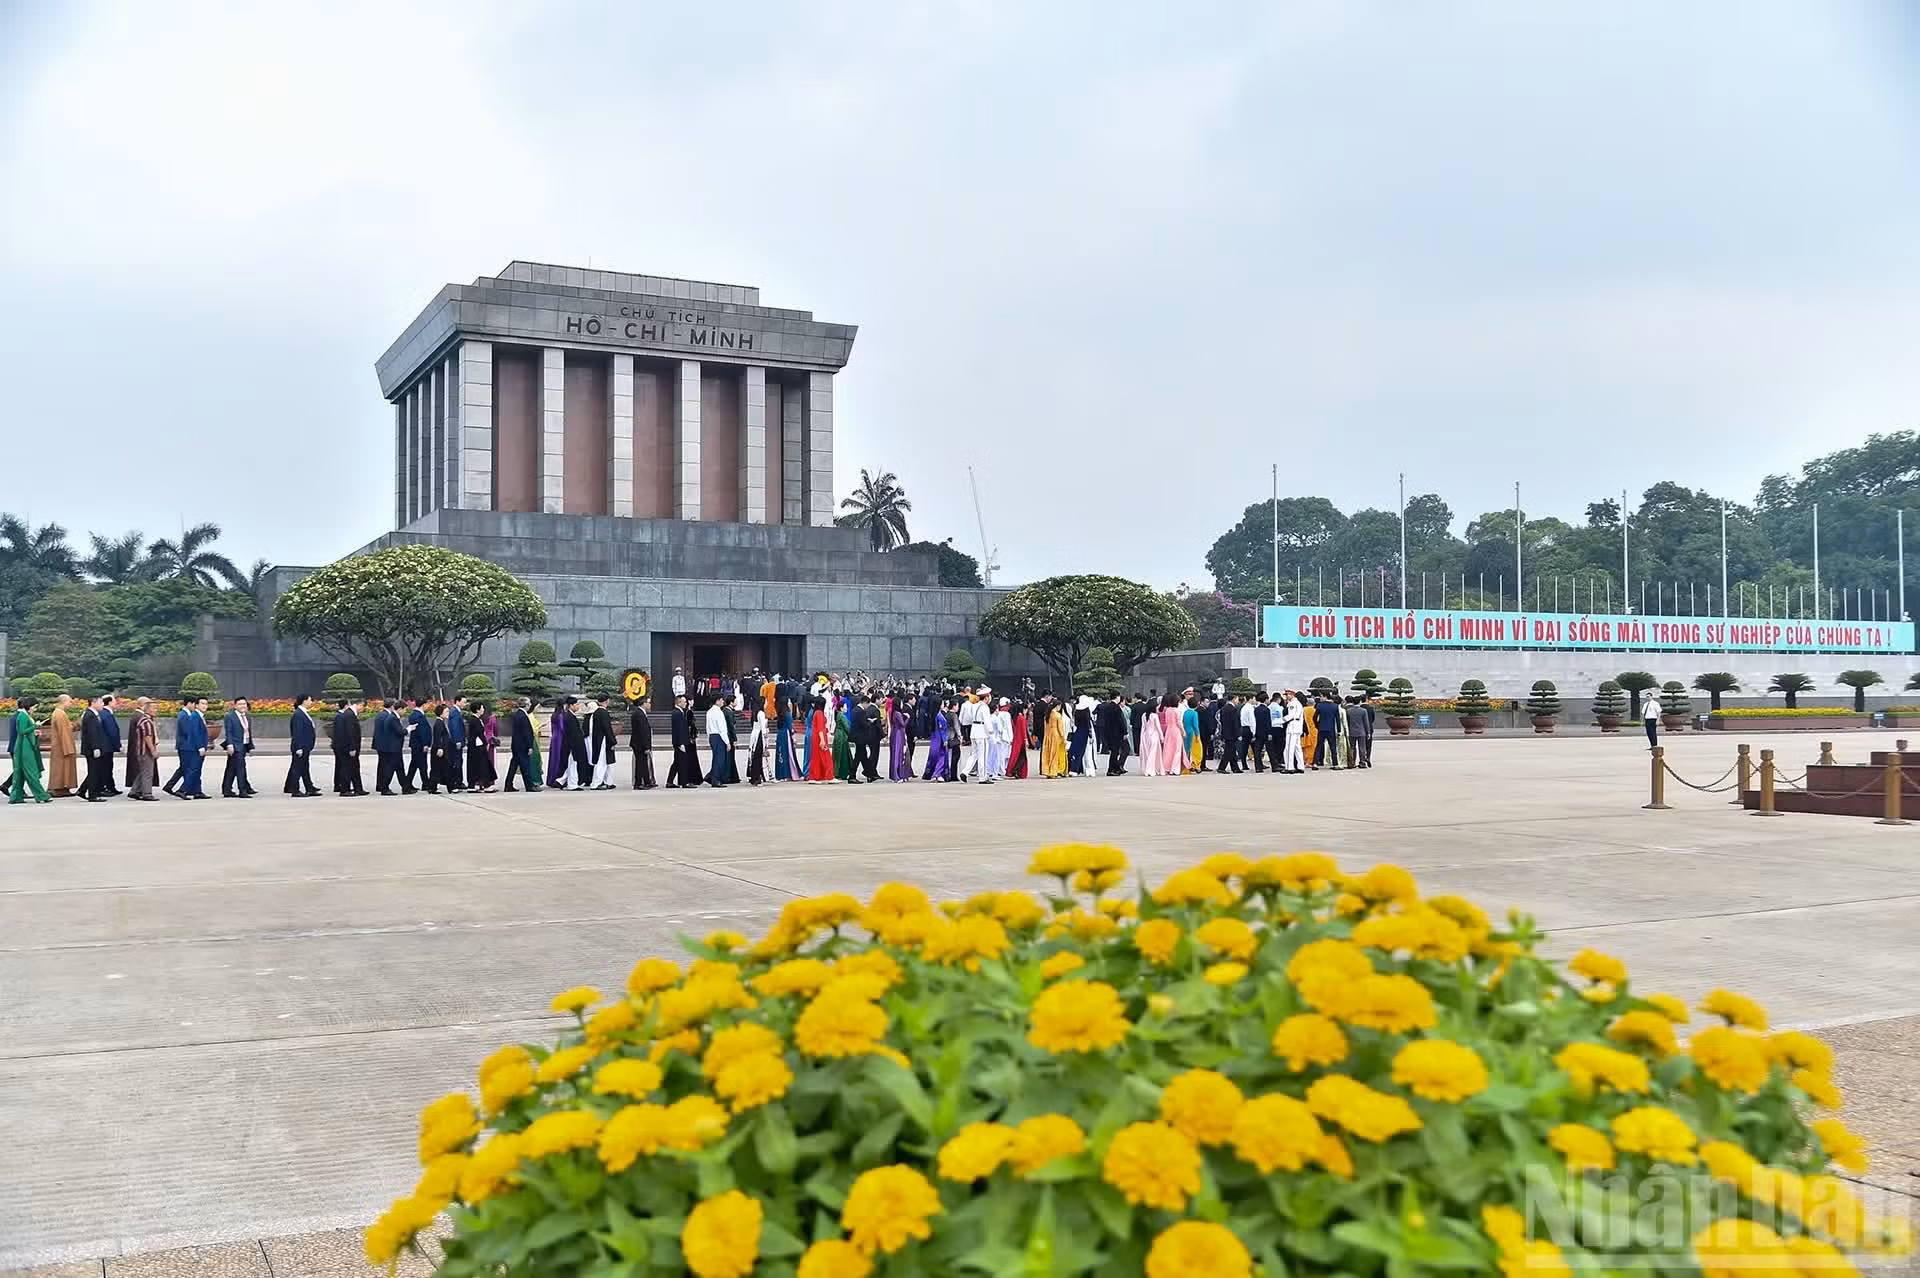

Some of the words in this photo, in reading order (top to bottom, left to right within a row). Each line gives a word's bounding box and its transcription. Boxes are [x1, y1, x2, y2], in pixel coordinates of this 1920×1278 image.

[690, 327, 753, 350] MINH
[1298, 608, 1336, 638] CHỦ
[1343, 615, 1385, 642] TỊCH
[1393, 609, 1415, 639] HỒ
[1423, 613, 1452, 640] CHÍ
[1460, 618, 1505, 641] MINH
[1512, 616, 1527, 641] VĨ
[1534, 620, 1561, 645] ĐẠI
[1568, 614, 1611, 642] SỐNG
[1617, 618, 1646, 643] MÃI
[1652, 623, 1700, 644] TRONG
[1706, 622, 1725, 648] SỰ
[1730, 621, 1781, 648] NGHIỆP
[1786, 620, 1813, 646] CỦA
[1818, 623, 1861, 646] CHÚNG
